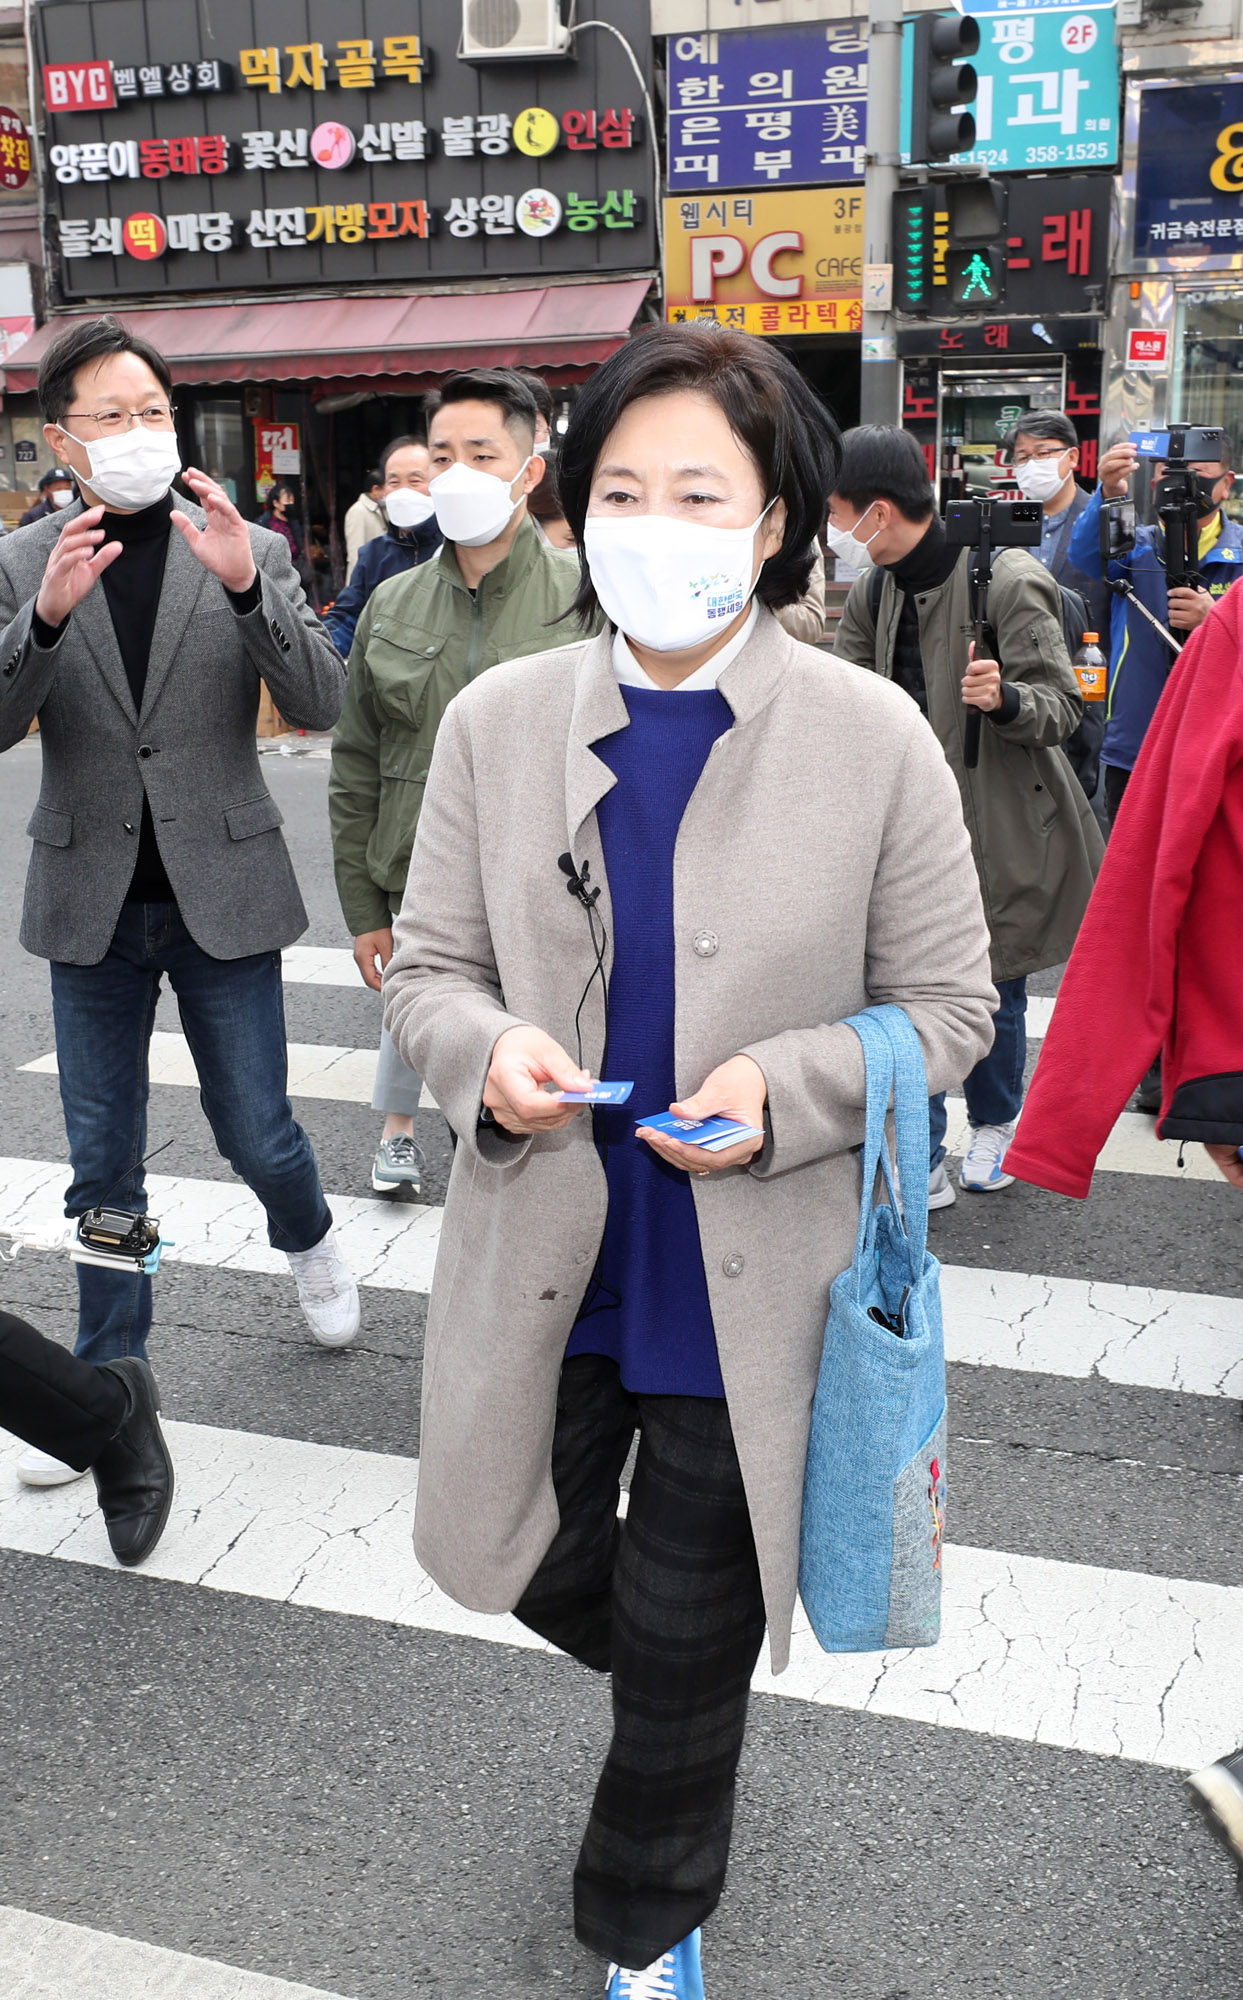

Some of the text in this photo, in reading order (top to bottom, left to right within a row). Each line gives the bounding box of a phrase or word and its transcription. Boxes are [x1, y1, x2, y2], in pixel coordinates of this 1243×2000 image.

[1066, 25, 1093, 45] 2F
[240, 35, 423, 94] 먹자골목
[48, 61, 221, 105] BYC 벧엘상회
[677, 63, 868, 106] 한의원
[441, 108, 636, 156] 불광 인삼
[1084, 118, 1111, 131] 의원
[242, 120, 427, 169] 꽃신 신발
[1025, 142, 1109, 164] 358-1525
[673, 145, 867, 183] 피부과
[444, 189, 637, 238] 상원 농산
[680, 199, 753, 230] 웹시티
[834, 198, 861, 219] 3F
[690, 231, 804, 304] PC
[815, 257, 862, 277] CAFE
[760, 302, 838, 332] 콜라텍
[938, 324, 1009, 348] 노래
[707, 589, 742, 607] 대한민국
[707, 601, 743, 618] 동행세일
